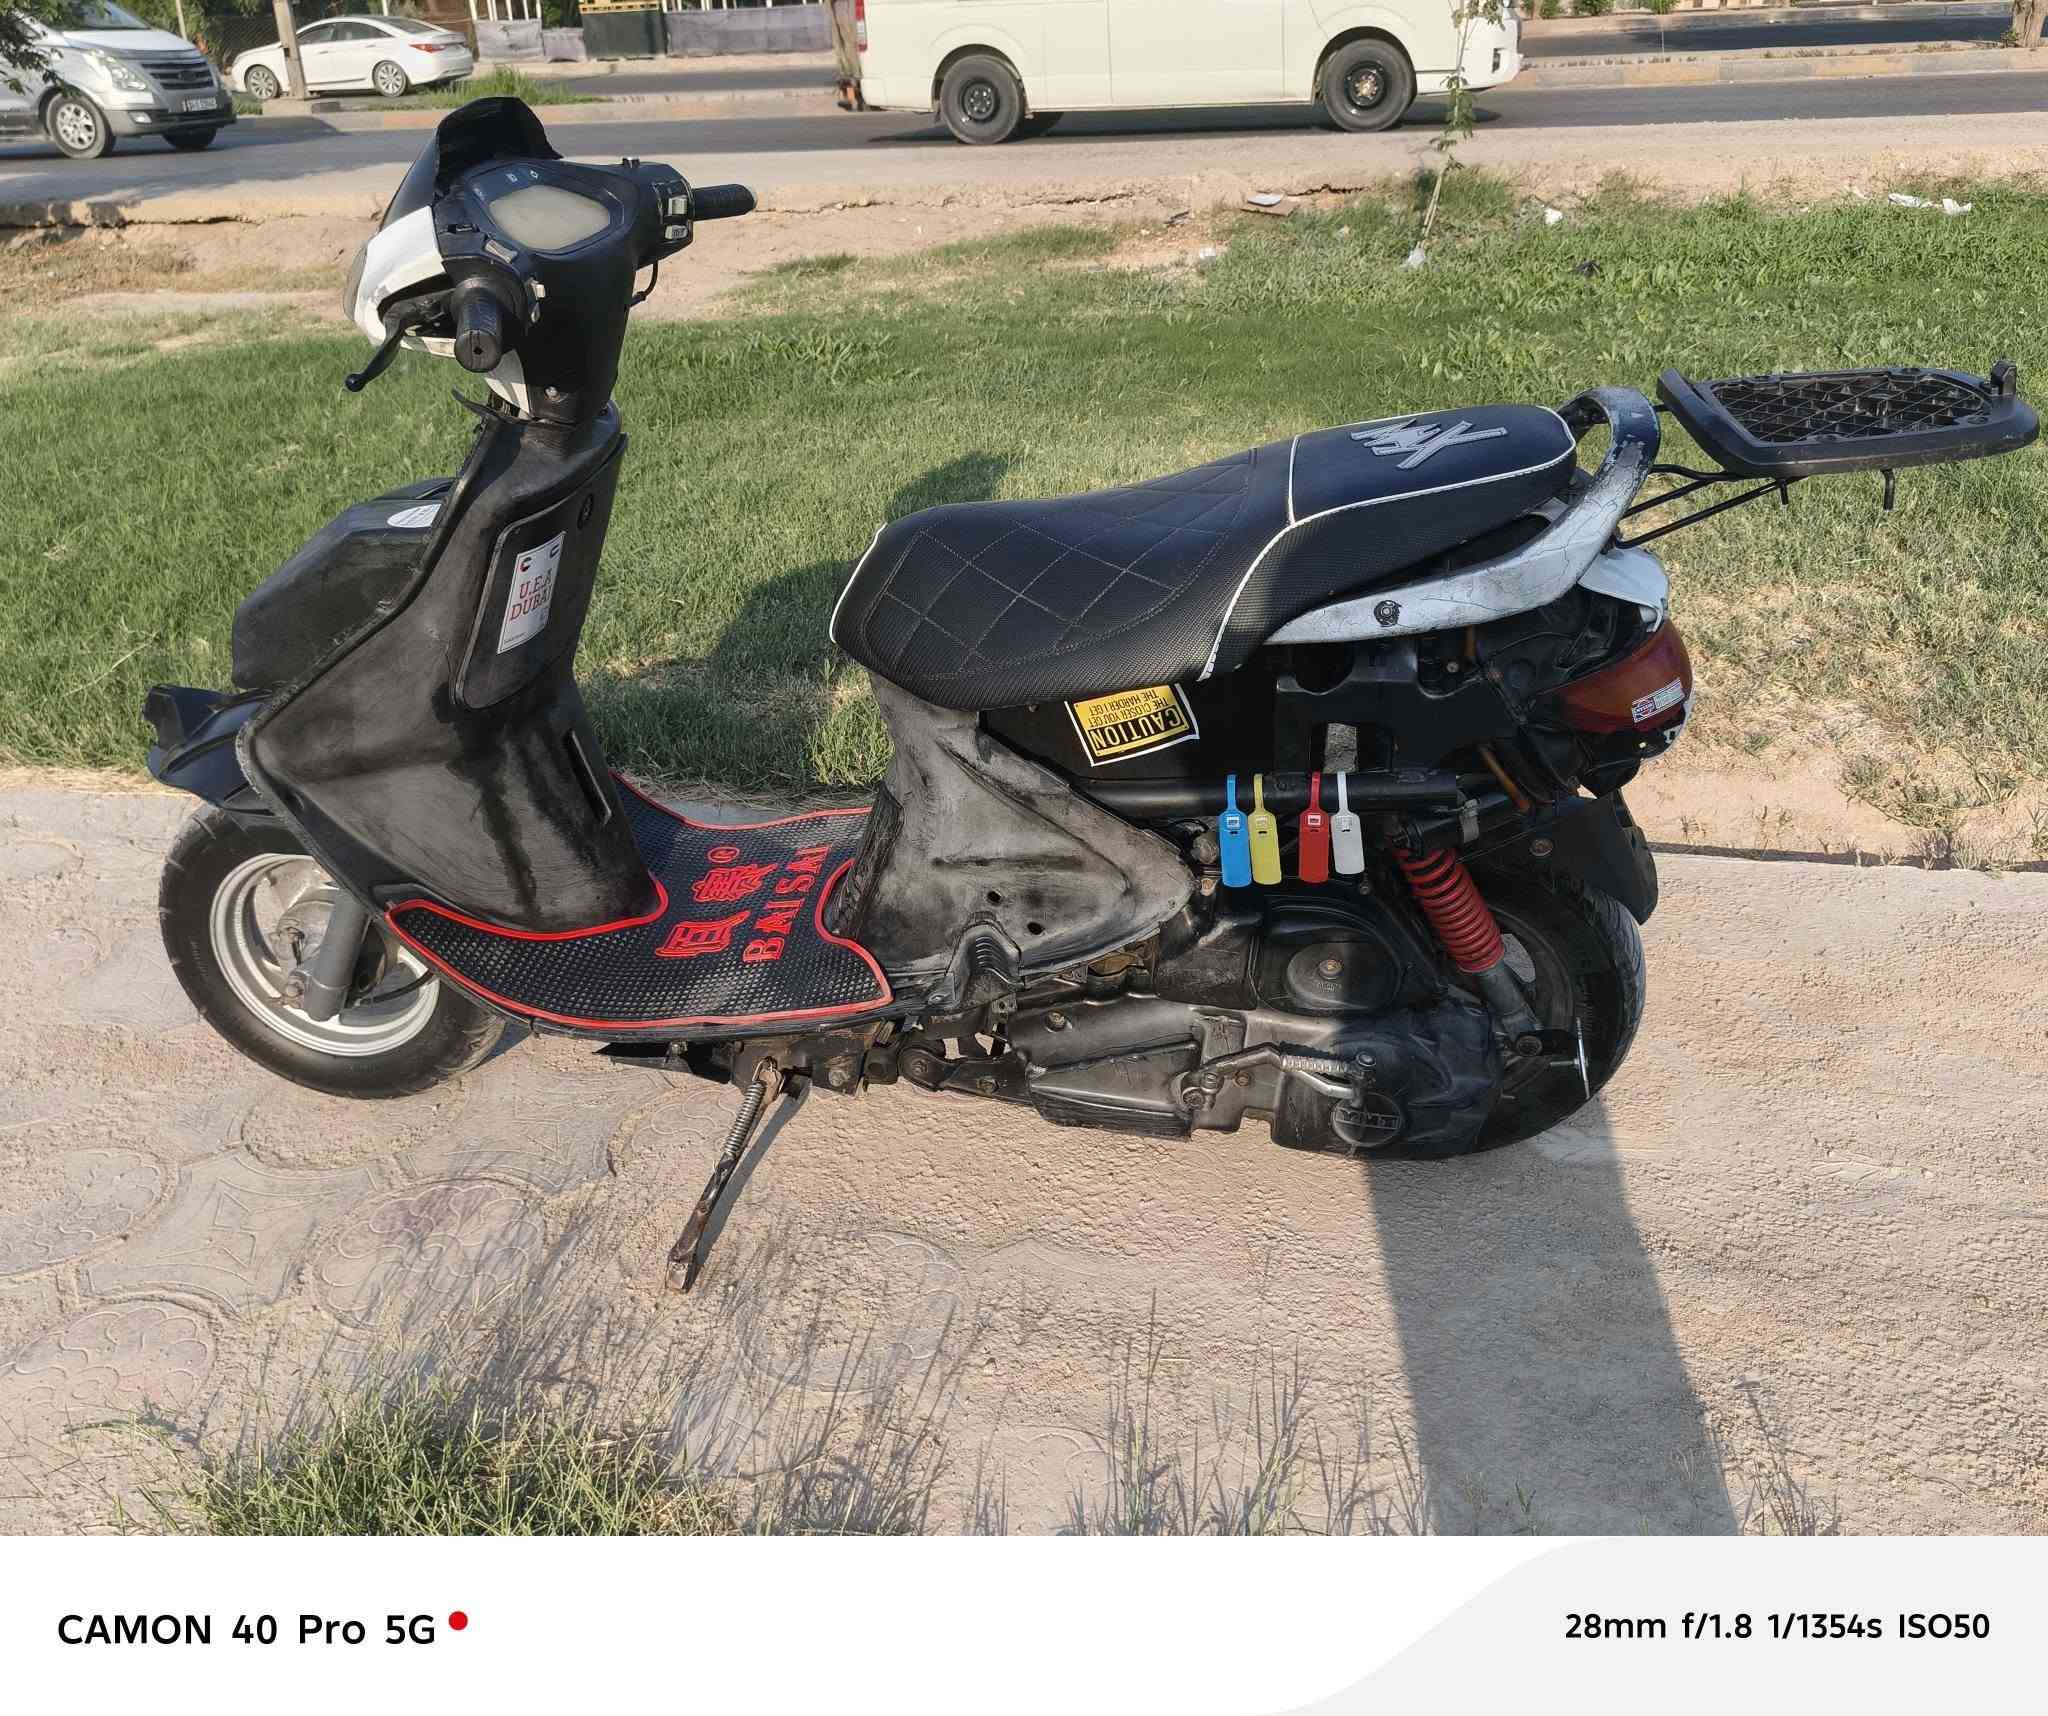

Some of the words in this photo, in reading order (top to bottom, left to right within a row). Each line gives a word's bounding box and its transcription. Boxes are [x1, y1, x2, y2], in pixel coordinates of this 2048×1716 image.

[1141, 688, 1160, 701] THE
[1110, 693, 1142, 711] HARDER
[1154, 697, 1169, 709] THE
[1088, 704, 1104, 716] GET
[1121, 702, 1152, 720] CLOSER
[1088, 714, 1106, 727] GET
[1107, 711, 1121, 723] YOU
[1090, 707, 1181, 749] CAUTION
[743, 897, 805, 964] BAI
